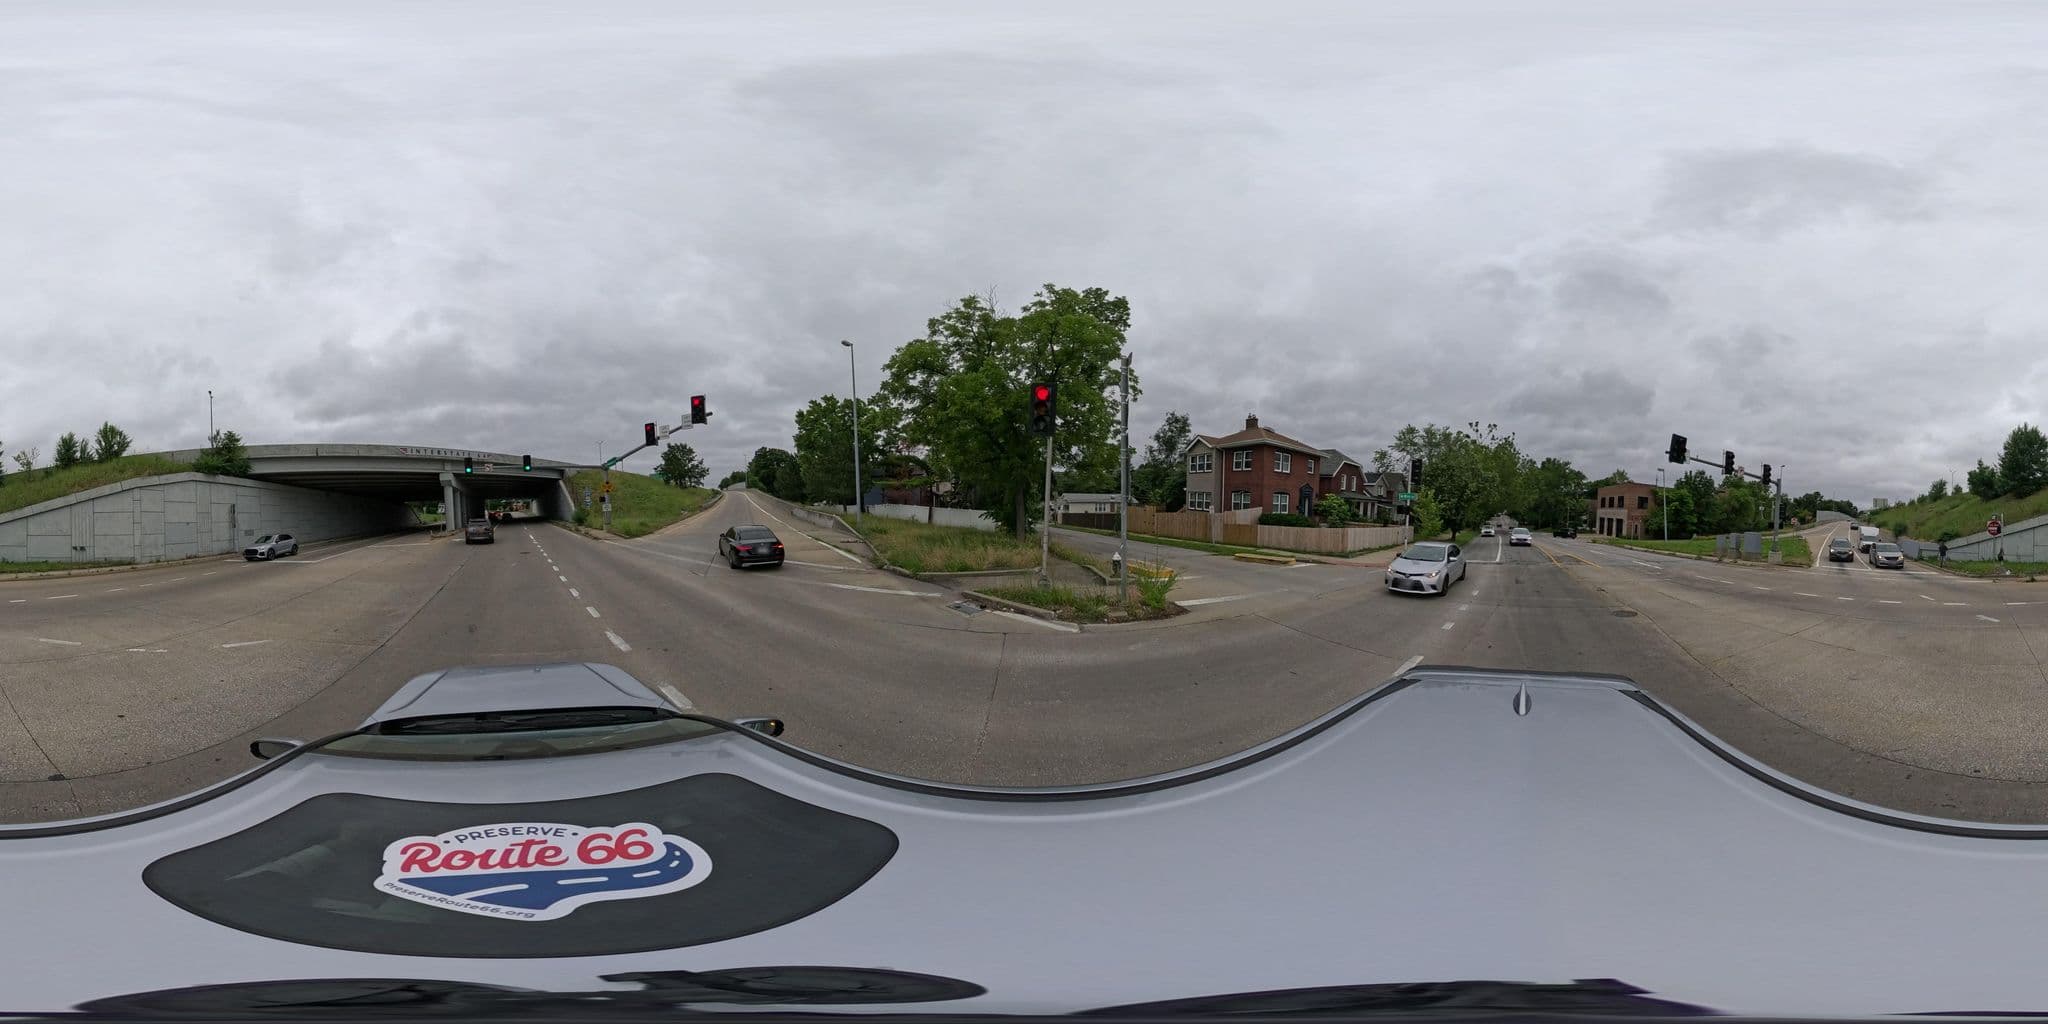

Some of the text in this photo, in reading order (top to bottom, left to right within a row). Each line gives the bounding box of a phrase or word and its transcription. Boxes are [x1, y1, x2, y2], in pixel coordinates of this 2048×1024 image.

[400, 828, 655, 873] Route 66
[455, 826, 568, 844] PRESERVE
[384, 881, 536, 919] PreserveRoute66.org
